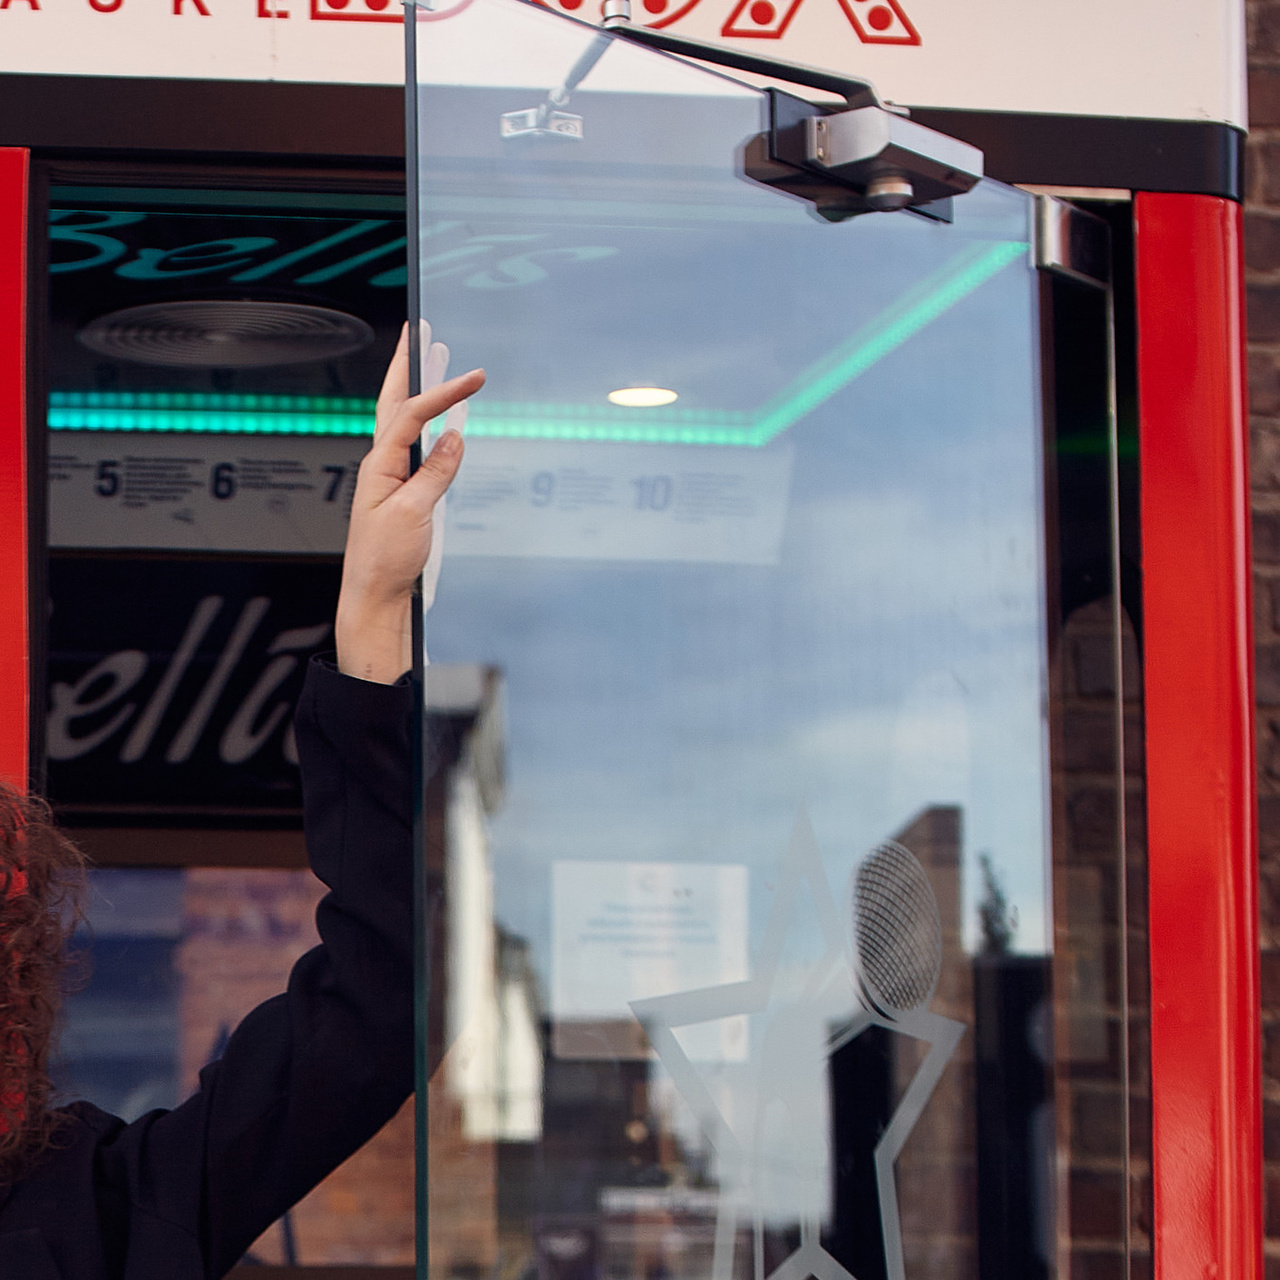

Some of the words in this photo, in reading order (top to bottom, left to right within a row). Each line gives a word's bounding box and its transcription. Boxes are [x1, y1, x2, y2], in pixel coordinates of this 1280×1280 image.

[95, 460, 120, 498] 5
[211, 462, 236, 500] 6
[322, 465, 345, 502] 7
[530, 470, 555, 507] 9
[631, 474, 673, 512] 10
[48, 596, 329, 765] elli
